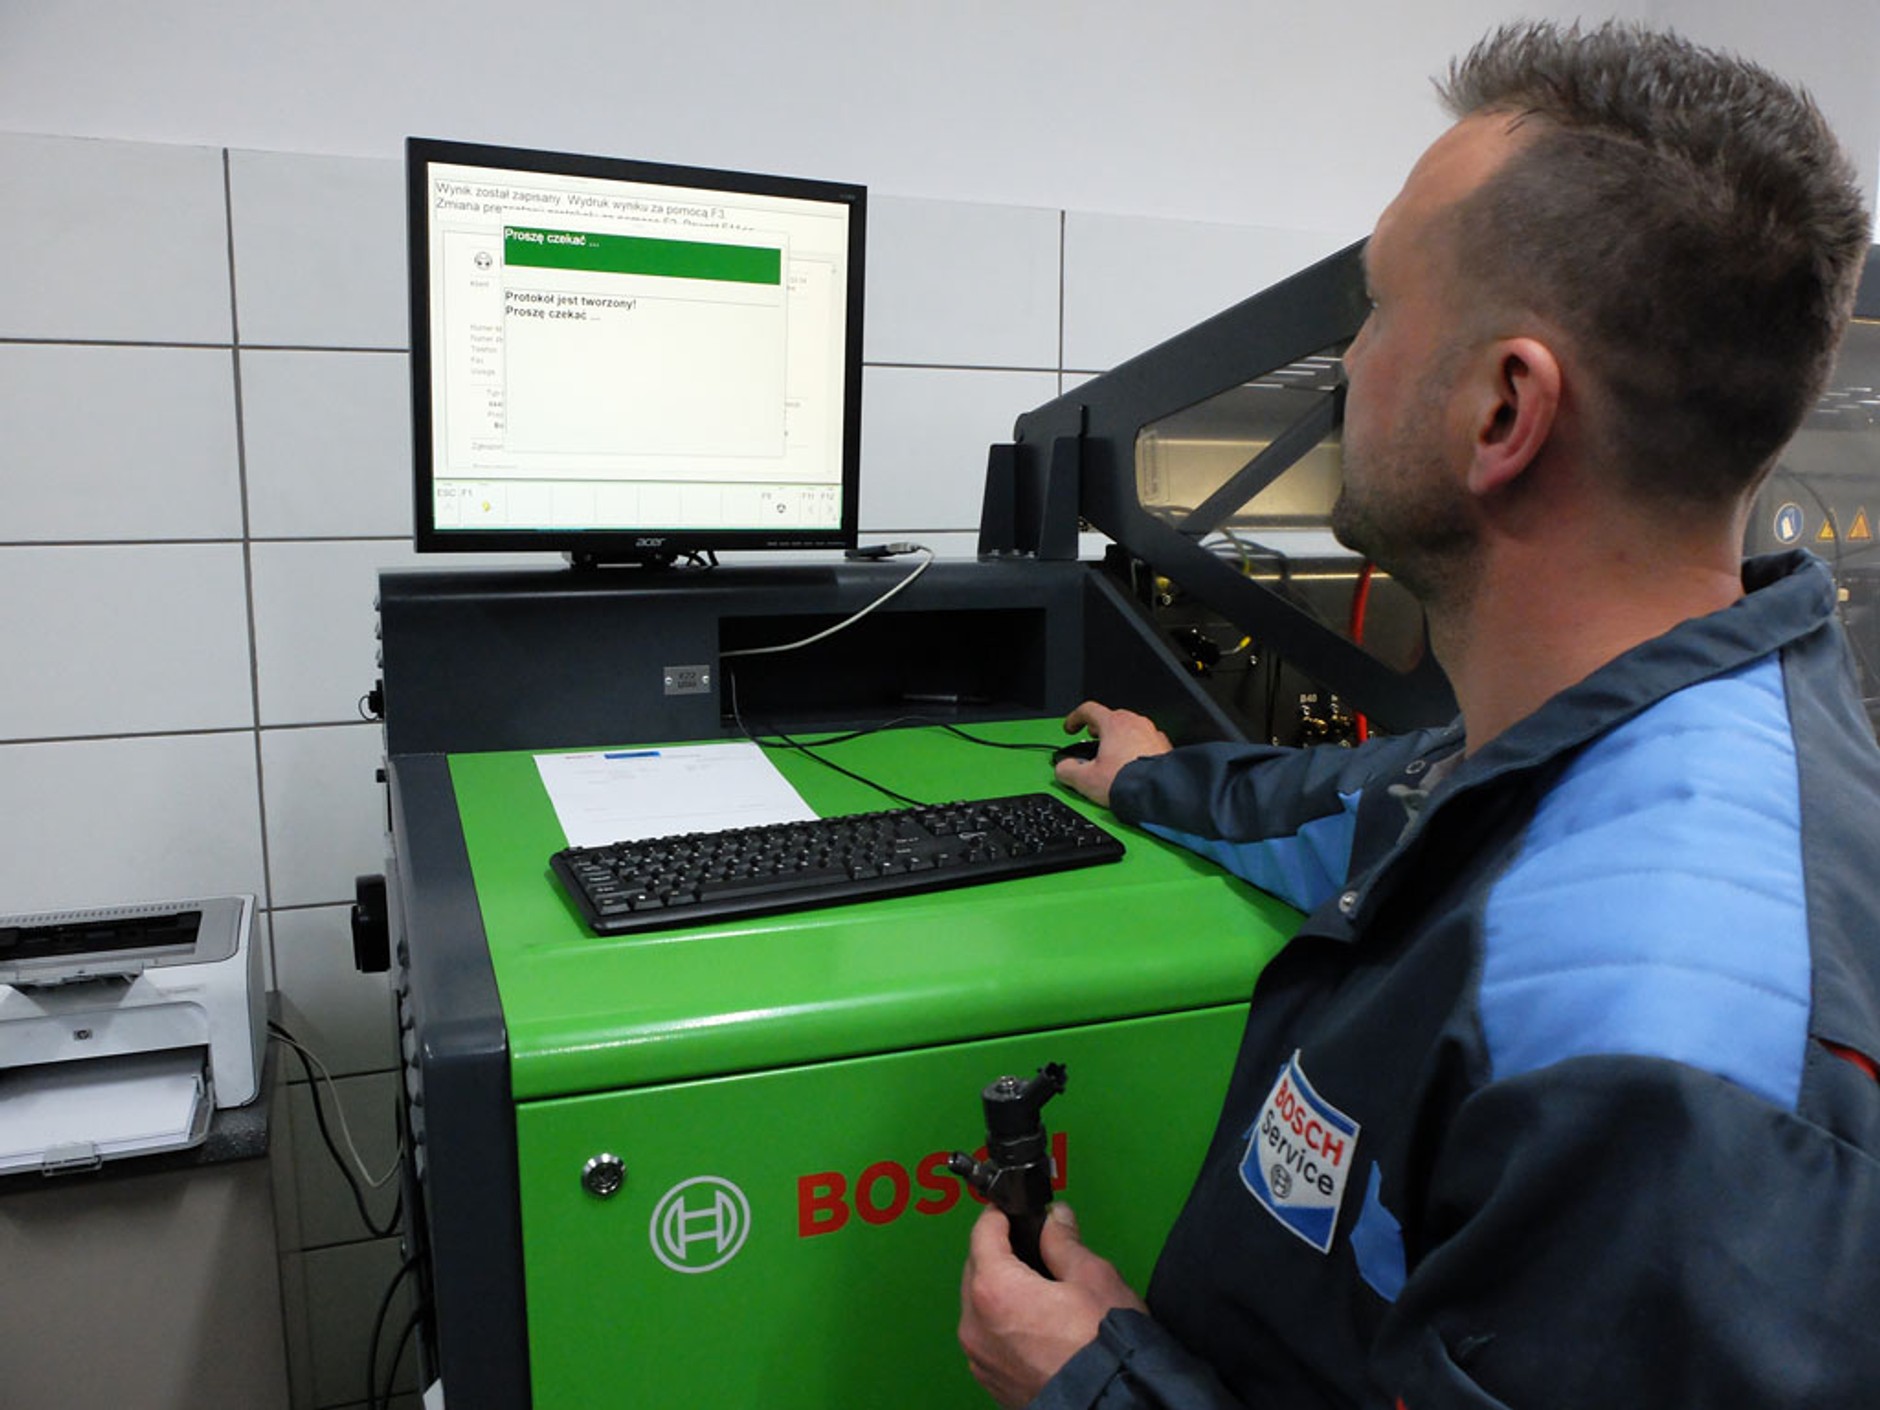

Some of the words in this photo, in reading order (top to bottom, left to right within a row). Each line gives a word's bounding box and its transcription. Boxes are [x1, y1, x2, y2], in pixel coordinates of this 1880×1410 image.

[435, 182, 472, 197] Wynik
[476, 186, 510, 199] został
[567, 194, 609, 209] Wydruk
[651, 204, 664, 214] za
[666, 205, 709, 218] pomocą
[435, 198, 480, 211] Zmiana
[504, 228, 545, 245] Proszę
[547, 232, 587, 246] czekać
[504, 291, 555, 304] Protokół
[556, 295, 579, 307] jest
[581, 297, 637, 310] tworzony!
[504, 305, 545, 319] Proszę
[548, 309, 587, 321] czekać
[1275, 1078, 1345, 1167] BOSCH
[796, 1132, 1068, 1239] BOS
